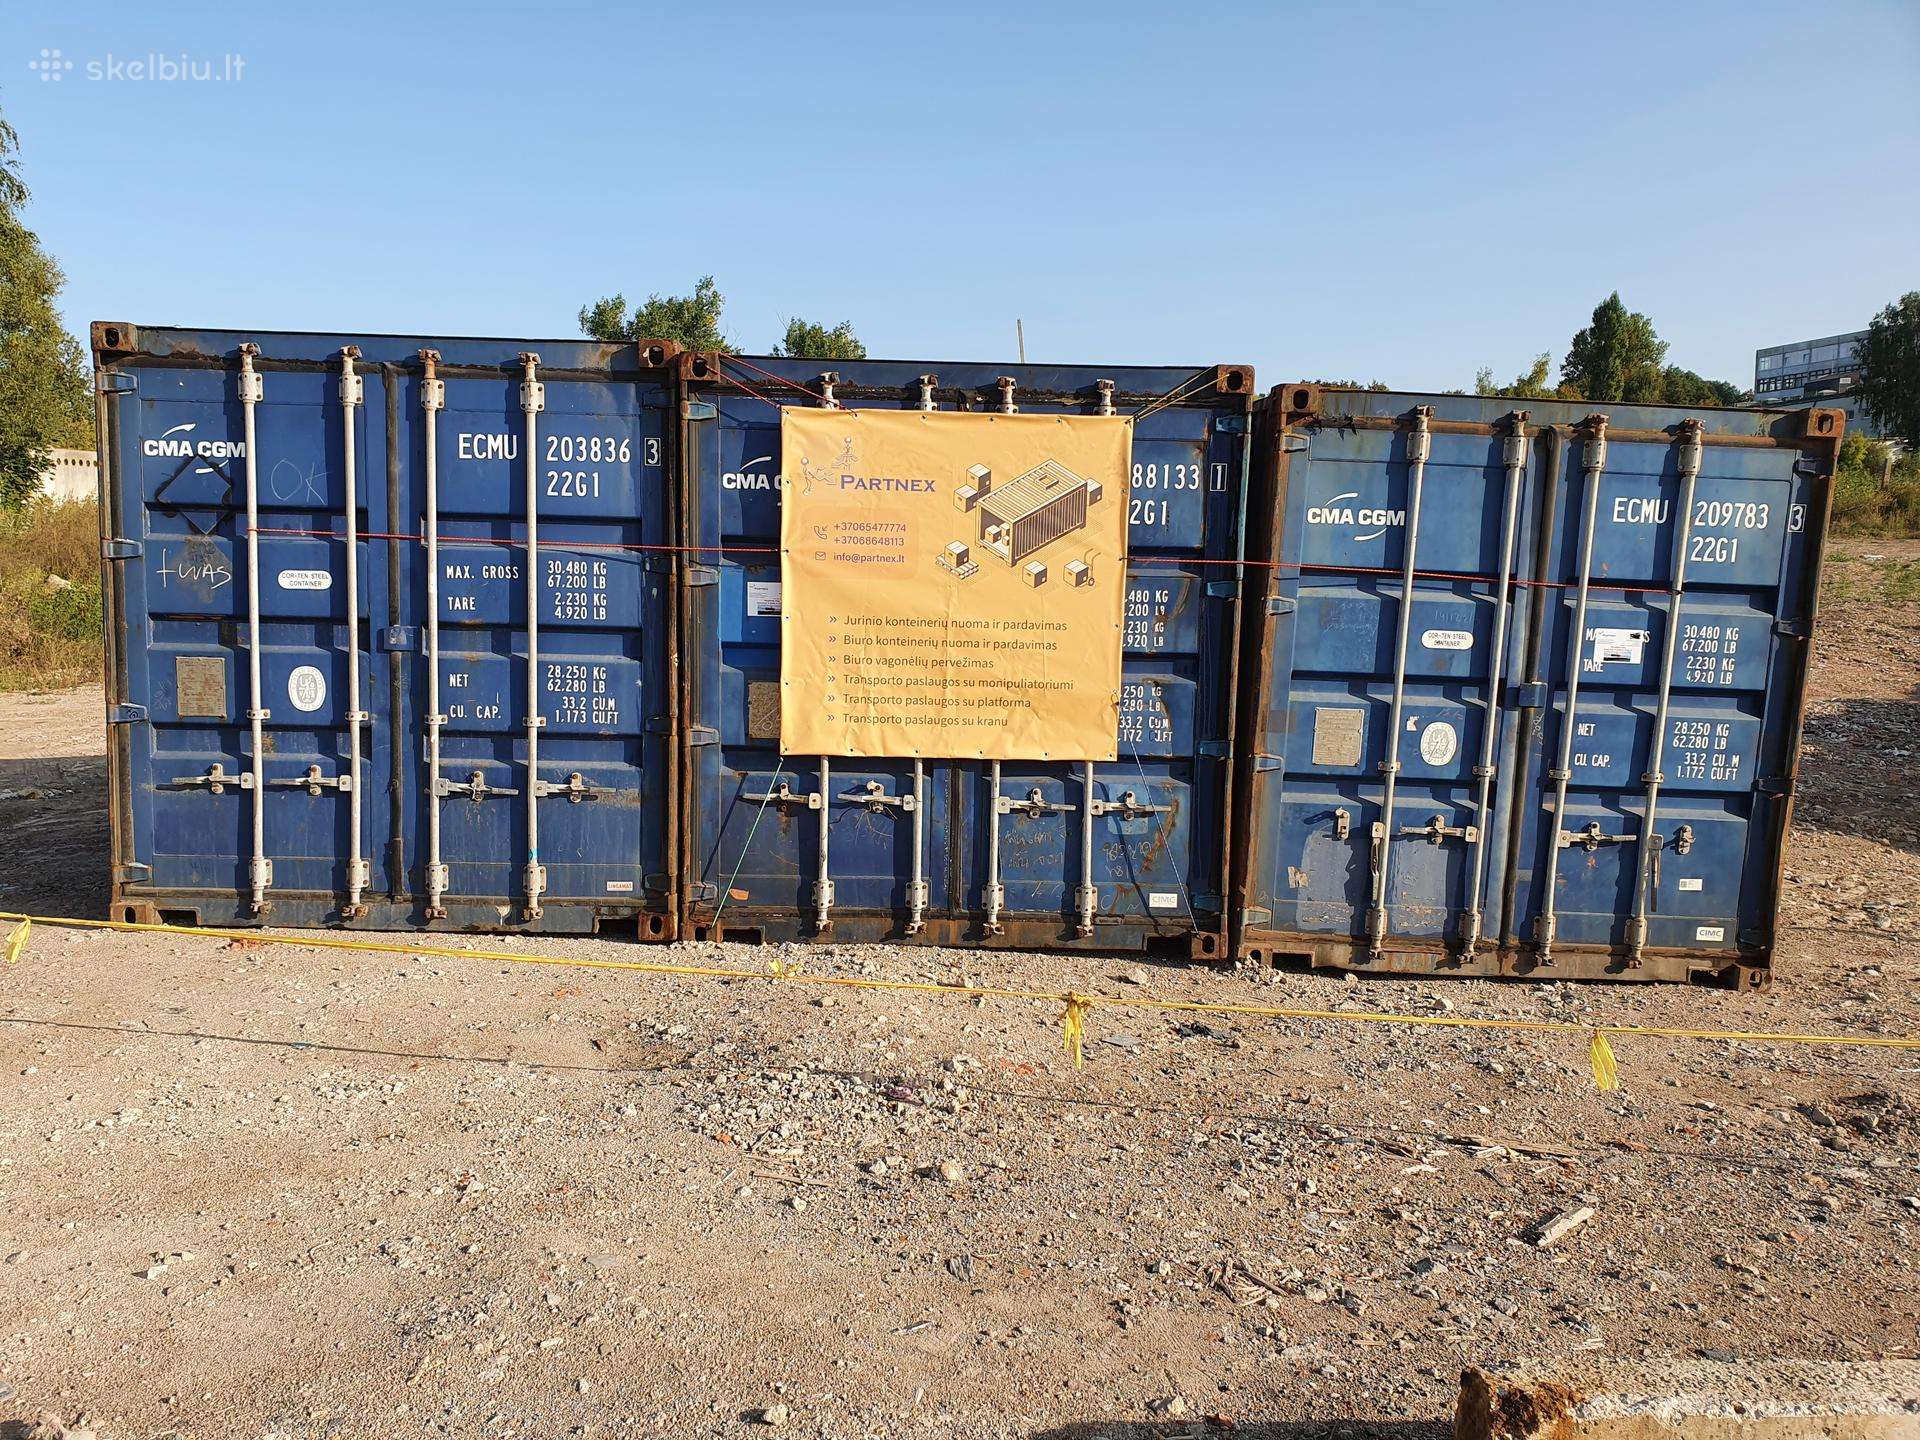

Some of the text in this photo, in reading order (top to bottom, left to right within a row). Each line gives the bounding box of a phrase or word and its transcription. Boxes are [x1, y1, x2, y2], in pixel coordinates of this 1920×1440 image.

[144, 440, 246, 458] CMA CGM
[458, 433, 660, 465] ECMU 203836 3
[271, 459, 334, 505] OK
[546, 471, 600, 498] 22G1
[722, 473, 770, 490] CMA
[1307, 507, 1406, 526] CMA CGM
[1613, 497, 1805, 531] ECMU 209783 3
[833, 521, 907, 533] +37065477774
[833, 535, 905, 547] +37068648113
[1690, 536, 1739, 563] 22G1
[833, 551, 905, 564] info@partnex.lt
[446, 565, 519, 579] MAX. GROSS
[593, 562, 607, 575] KG
[593, 576, 606, 589] LB
[447, 597, 476, 611] TARE
[593, 594, 607, 607] KG
[1155, 590, 1169, 604] KG
[593, 607, 606, 620] LB
[843, 615, 1068, 631] Jurinio konteinerių nuoma ir pardavimas
[1154, 621, 1164, 633] KG
[1725, 626, 1739, 640] KG
[843, 634, 1058, 651] Biuro konteinerių nuoma ir pardavimas
[1153, 636, 1164, 647] LB
[1724, 641, 1737, 654] LB
[843, 654, 994, 669] Biuro vagonėlių pervežimas
[1583, 658, 1604, 673] TARE
[1722, 658, 1736, 672] KG
[592, 666, 607, 680] KG
[1719, 672, 1733, 685] LB
[449, 673, 469, 688] NET
[592, 680, 606, 693] LB
[843, 674, 1074, 691] Transporto paslaugos su monipuliatoriumi
[1151, 686, 1162, 697] KG
[562, 696, 587, 710] 33.2
[842, 693, 1031, 709] Transporto paslaugos su platforma
[1149, 699, 1161, 712] LB
[449, 704, 502, 719] CU. CAP.
[592, 710, 619, 725] CU.FT
[842, 713, 1008, 728] Transporto paslaugos su kranu
[1119, 716, 1142, 729] 33.2
[1577, 723, 1596, 737] NET
[1716, 723, 1730, 737] KG
[1714, 736, 1727, 750] LB
[1591, 754, 1610, 768] CAP.
[1684, 752, 1706, 766] 33.2
[1710, 766, 1738, 781] CU.FT
[1700, 929, 1722, 937] CIMC
